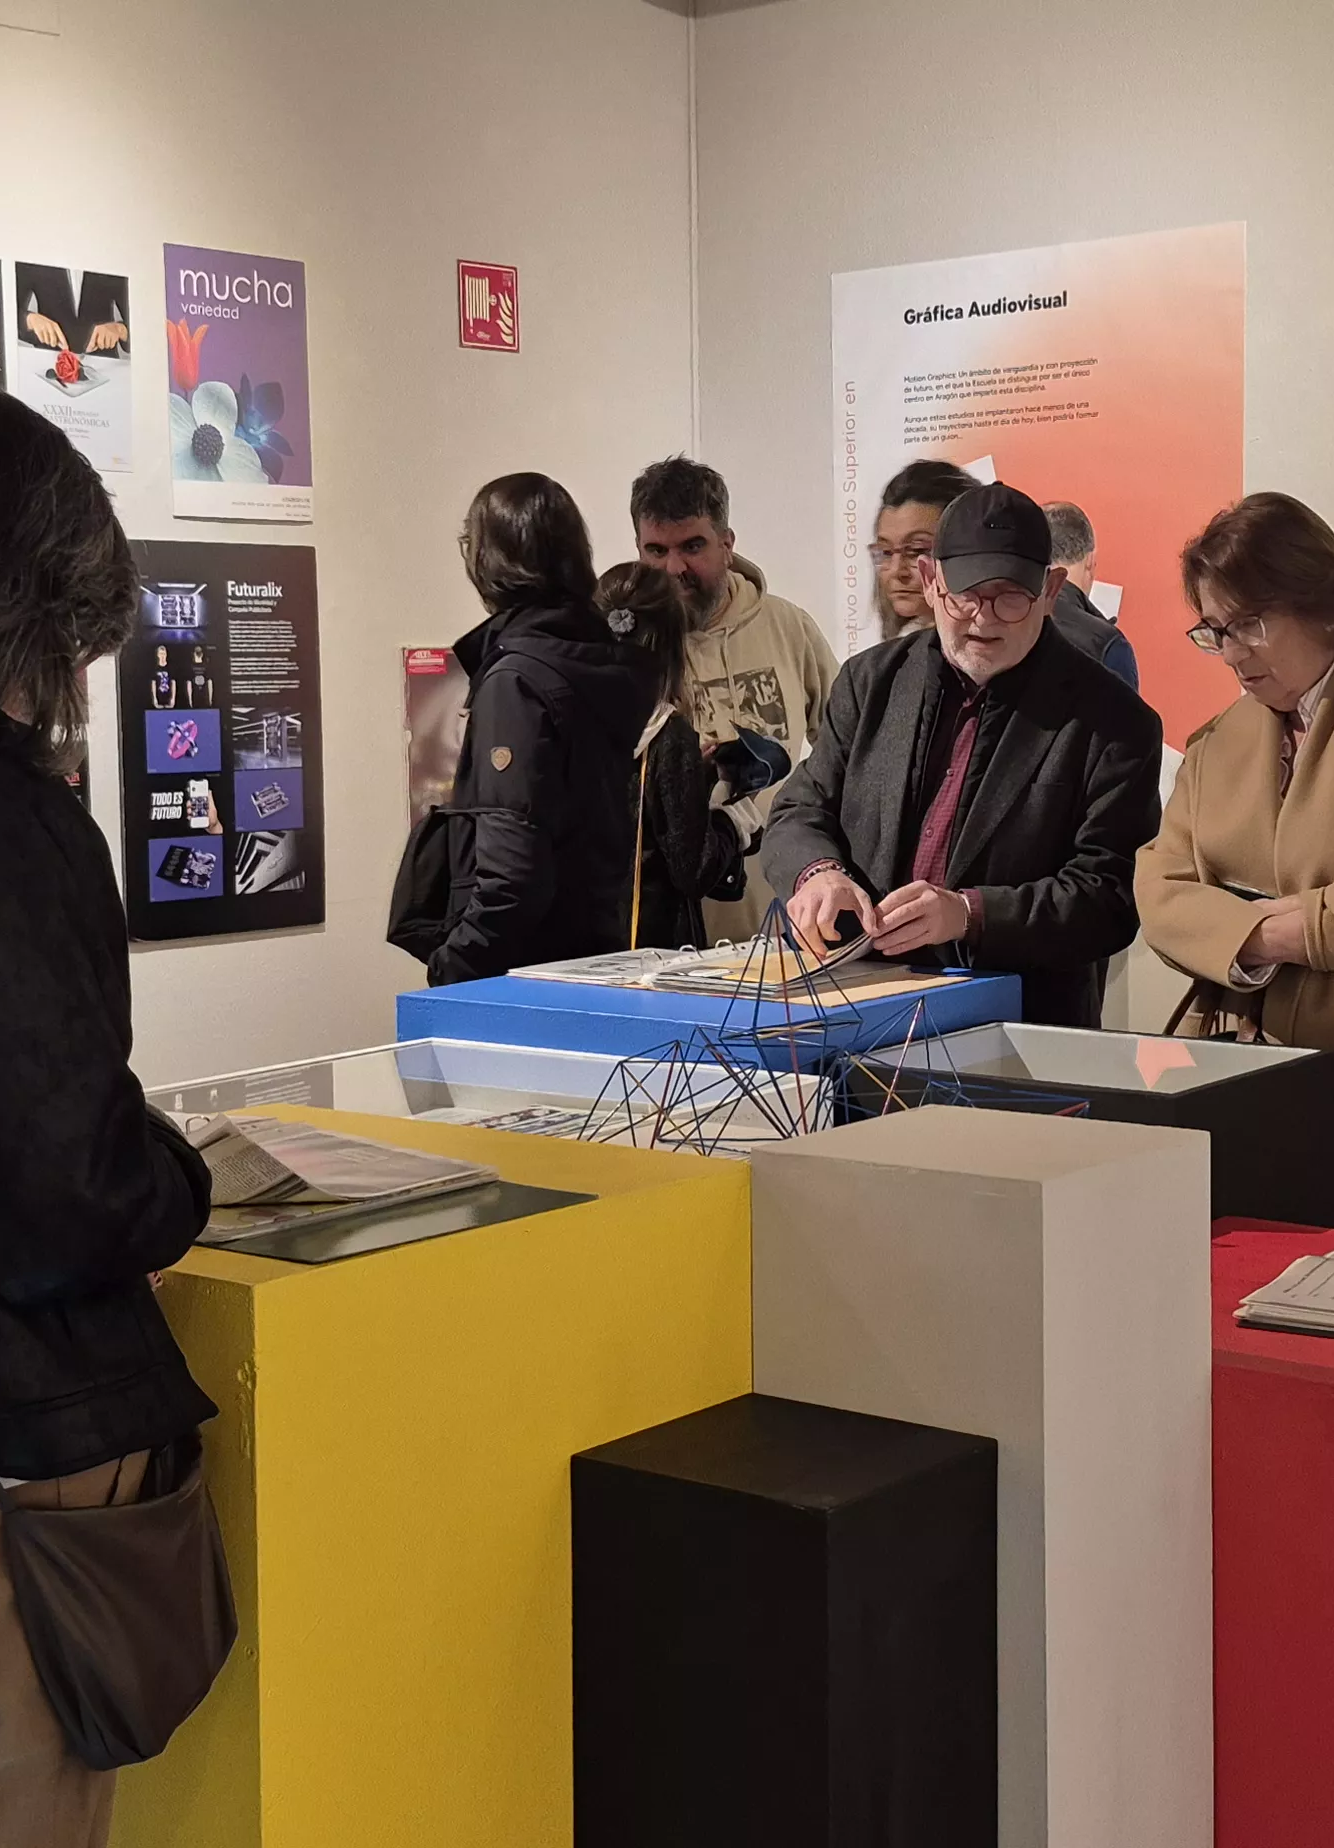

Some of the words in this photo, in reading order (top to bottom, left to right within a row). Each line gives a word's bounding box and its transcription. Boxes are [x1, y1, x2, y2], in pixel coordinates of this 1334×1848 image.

[179, 268, 293, 309] mucha
[180, 301, 240, 320] variedad
[903, 303, 965, 326] Gráfica
[968, 289, 1068, 319] Audiovisual
[992, 367, 1001, 375] de
[1039, 363, 1045, 372] y
[972, 378, 997, 387] Escuela
[1039, 373, 1050, 382] por
[1063, 371, 1070, 379] el
[845, 380, 856, 405] en
[935, 392, 959, 404] Aragón
[959, 391, 972, 399] que
[999, 387, 1013, 395] esta
[1066, 402, 1076, 410] de
[1076, 401, 1090, 409] una
[974, 419, 992, 428] hasta
[842, 411, 859, 493] Superior
[842, 498, 858, 559] Grado
[843, 564, 858, 589] de
[226, 580, 284, 598] Futuralix
[151, 792, 173, 806] TODO
[172, 791, 185, 805] ES
[150, 806, 183, 821] FUTURO
